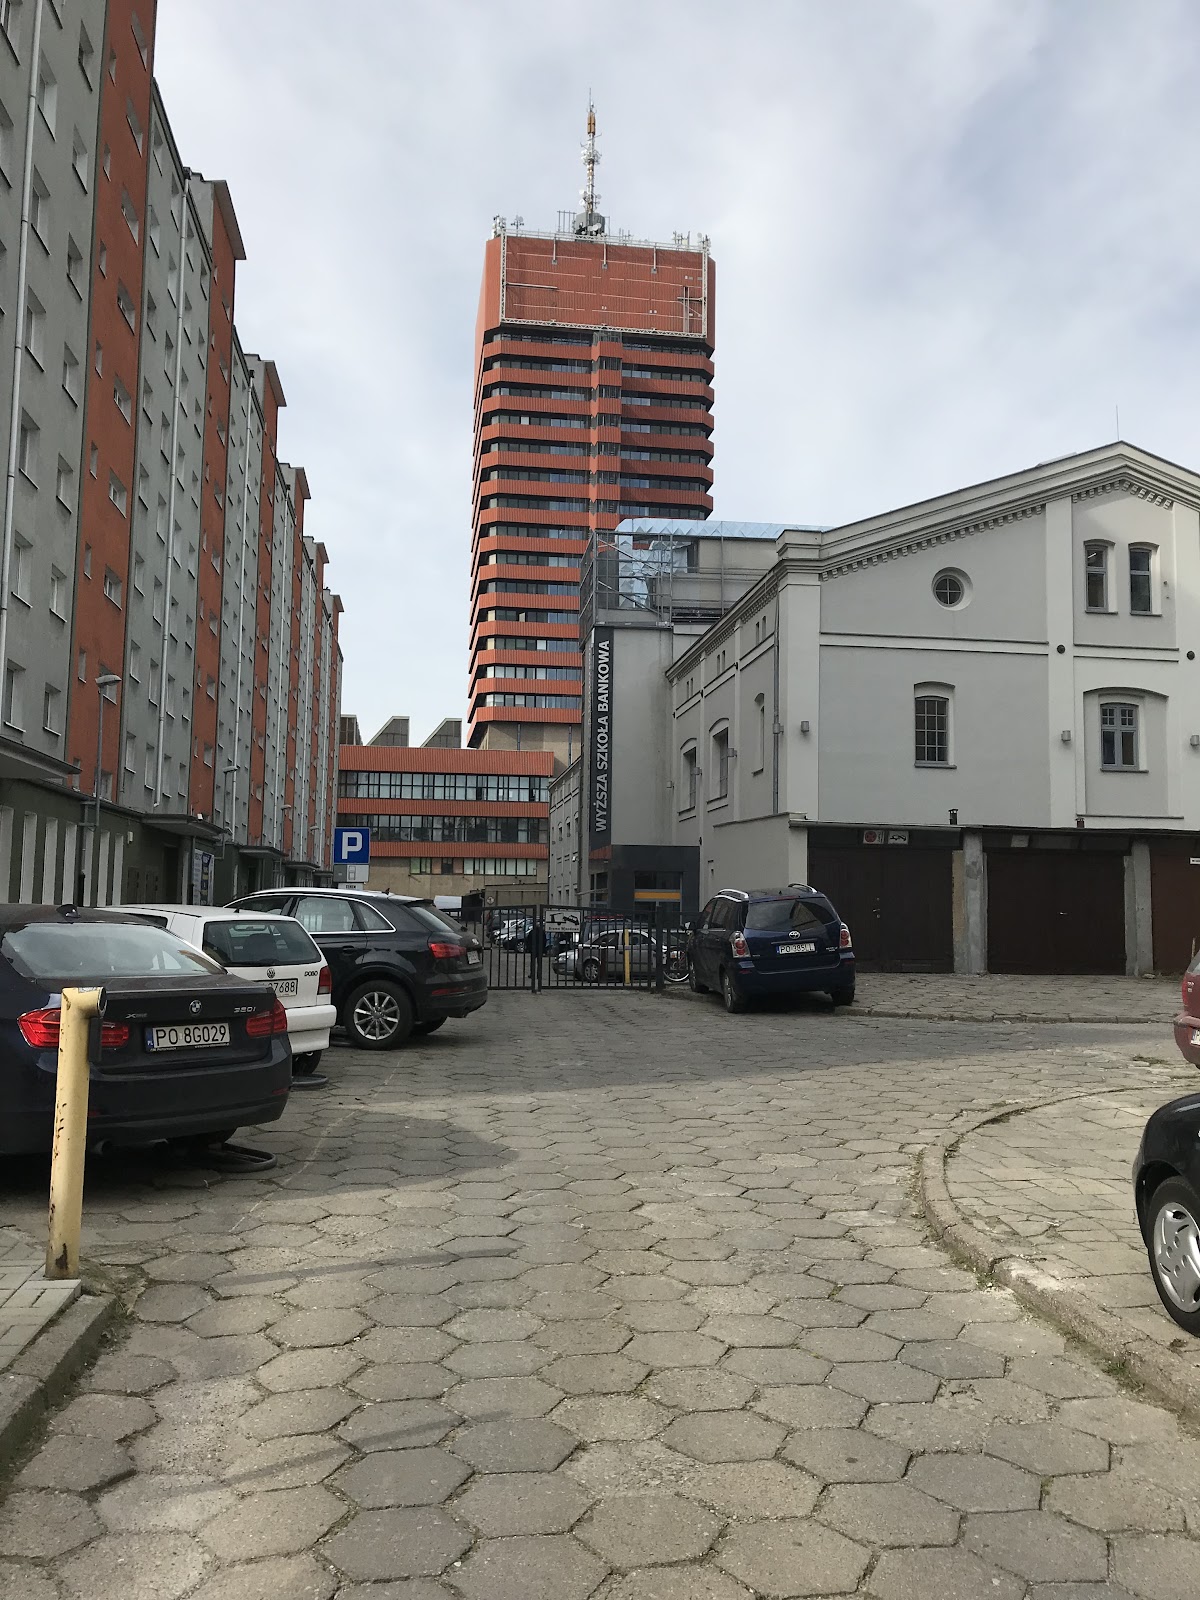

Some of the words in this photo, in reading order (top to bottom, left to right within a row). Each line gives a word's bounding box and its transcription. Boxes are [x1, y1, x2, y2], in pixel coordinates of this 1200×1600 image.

[597, 640, 610, 712] BANKOWA
[597, 716, 609, 770] SZKOŁA
[593, 774, 608, 832] WYŻSZA
[341, 831, 363, 860] P
[155, 1028, 178, 1047] PO
[183, 1025, 227, 1044] 8G029
